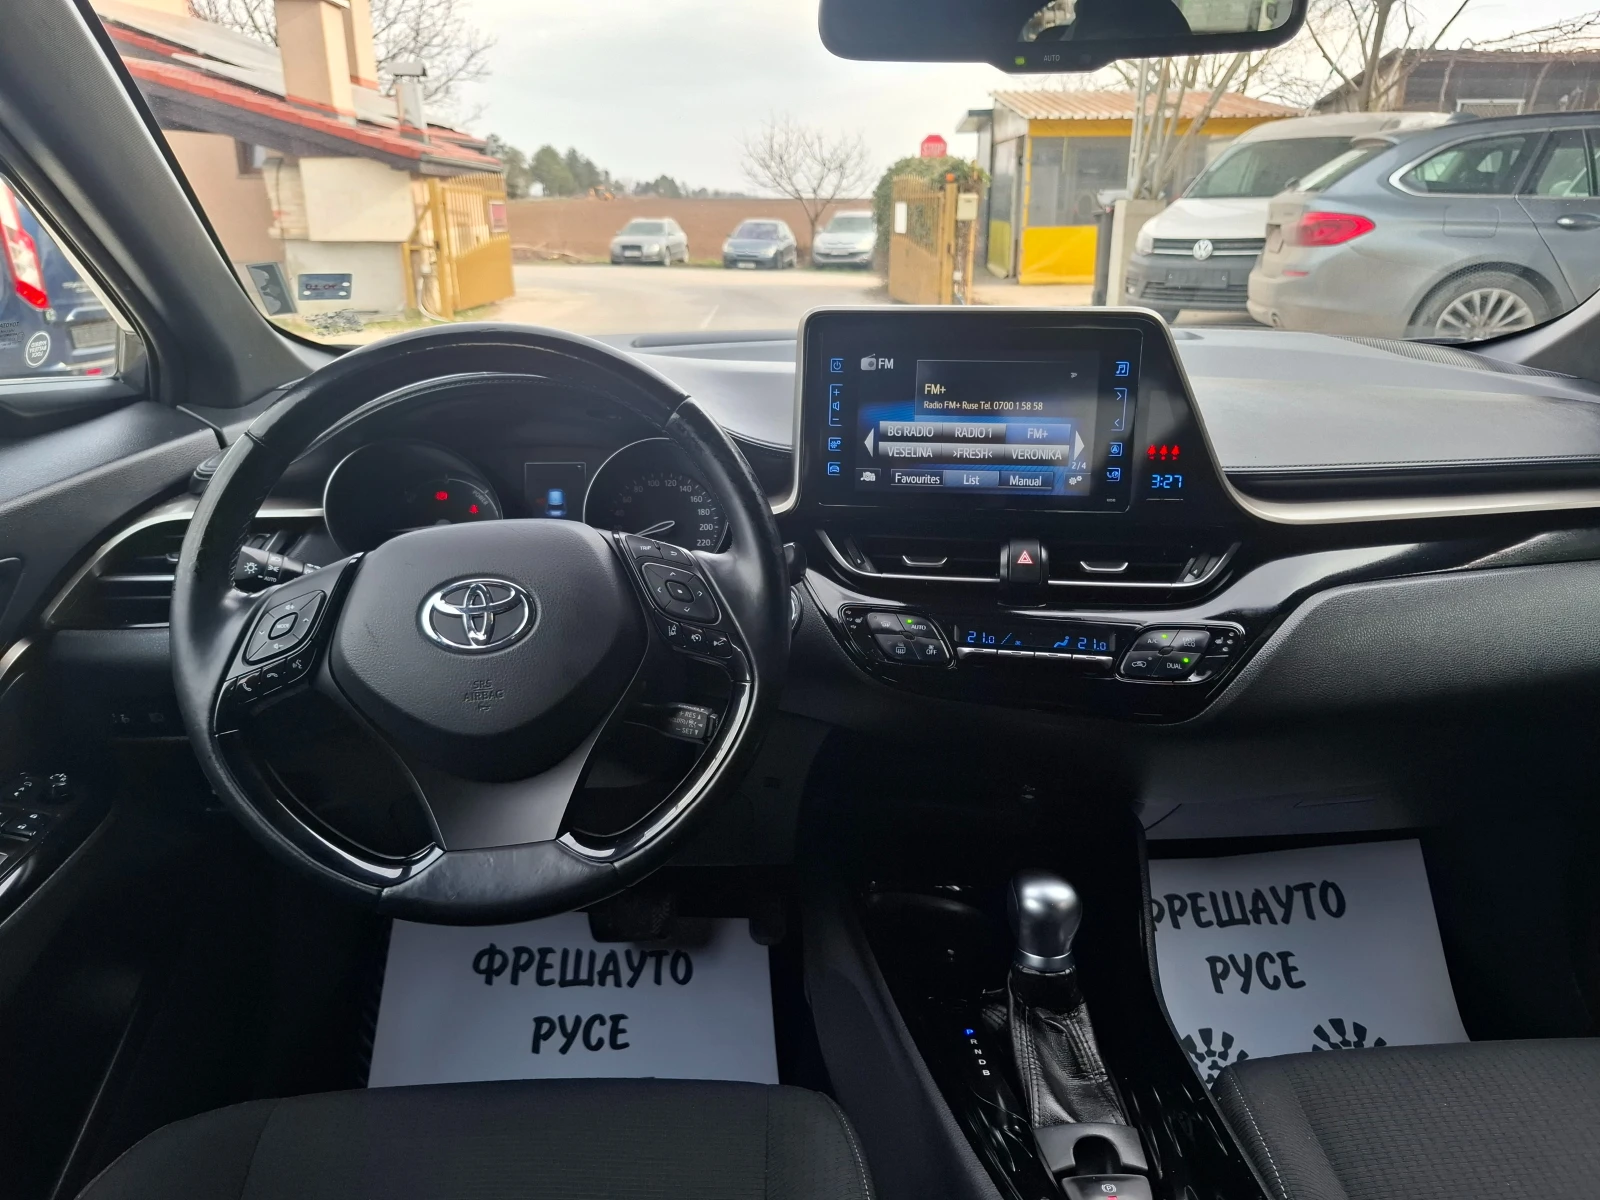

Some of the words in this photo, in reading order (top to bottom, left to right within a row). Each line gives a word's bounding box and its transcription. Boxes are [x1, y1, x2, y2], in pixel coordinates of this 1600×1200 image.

[1044, 54, 1060, 62] AUTO
[878, 358, 894, 369] FM
[924, 383, 946, 394] FM+
[924, 400, 942, 409] Radio
[944, 401, 960, 409] FM+
[962, 402, 978, 410] Ruse
[980, 402, 992, 410] Tel.
[994, 402, 1014, 410] 0700
[1021, 402, 1031, 410] 58
[1033, 402, 1043, 410] 58
[888, 426, 902, 436] BG
[904, 426, 934, 438] RADIO
[955, 427, 986, 438] RADIO
[1027, 428, 1048, 439] FM+
[888, 446, 933, 458] VESELINA
[1012, 449, 1062, 460] VERONIKA
[1072, 462, 1086, 470] 2/4
[895, 472, 940, 484] Favourites
[963, 474, 980, 485] List
[1009, 475, 1042, 486] Manual
[1151, 474, 1182, 488] 3:27
[472, 490, 488, 505] POWER
[698, 508, 710, 516] 180
[967, 630, 995, 644] 21.0
[1077, 637, 1106, 650] 21.0
[473, 680, 492, 689] SRS
[464, 690, 504, 702] AIRBAG
[472, 943, 694, 988] ФРЕШАУТО
[1205, 951, 1306, 994] РУСЕ
[531, 1014, 630, 1055] РУСЕ
